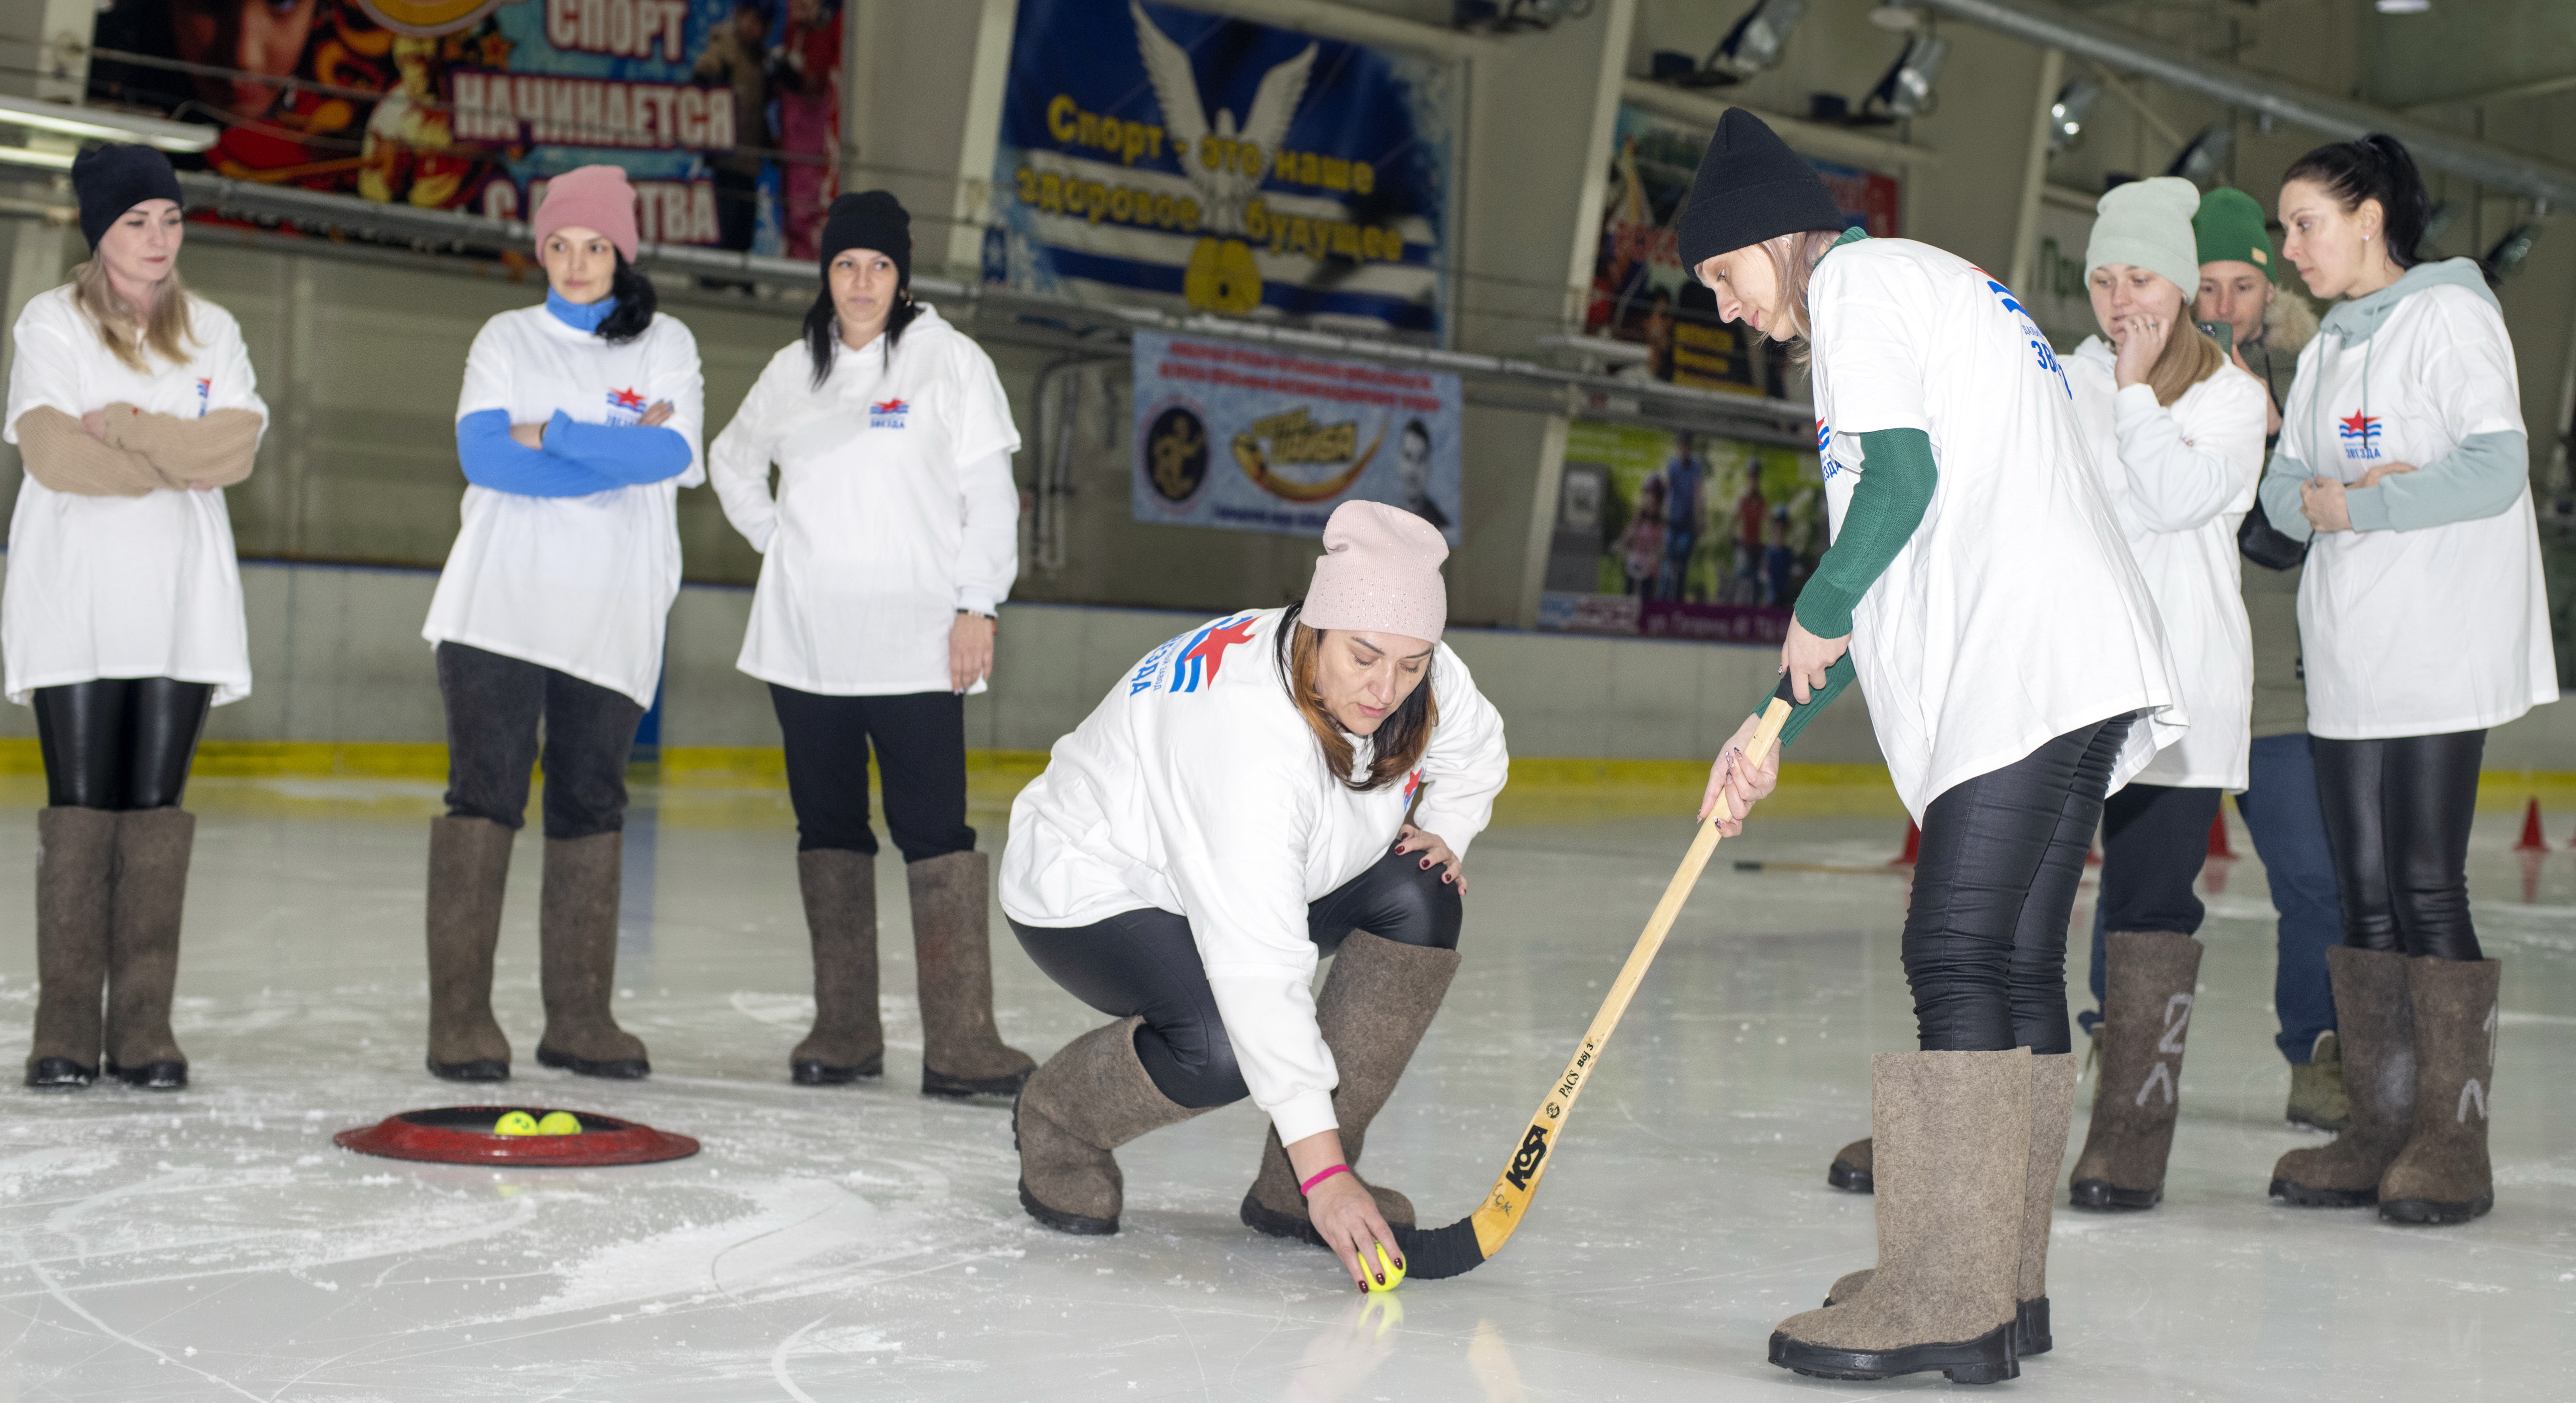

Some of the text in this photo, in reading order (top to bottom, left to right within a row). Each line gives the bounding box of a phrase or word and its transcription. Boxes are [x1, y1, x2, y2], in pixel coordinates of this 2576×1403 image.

[548, 0, 687, 62] СПОРТ
[453, 72, 736, 149] НАЧИНАЕТСЯ
[1047, 94, 1162, 164] Спорт
[1203, 135, 1261, 175] это
[1275, 148, 1374, 194] наше
[1017, 168, 1402, 264] здоровое будущее
[1153, 665, 1167, 691] ЗАВОД
[1559, 1070, 1579, 1098] PACS
[1577, 1051, 1591, 1067] Böj
[1506, 1124, 1548, 1192] KOSA
